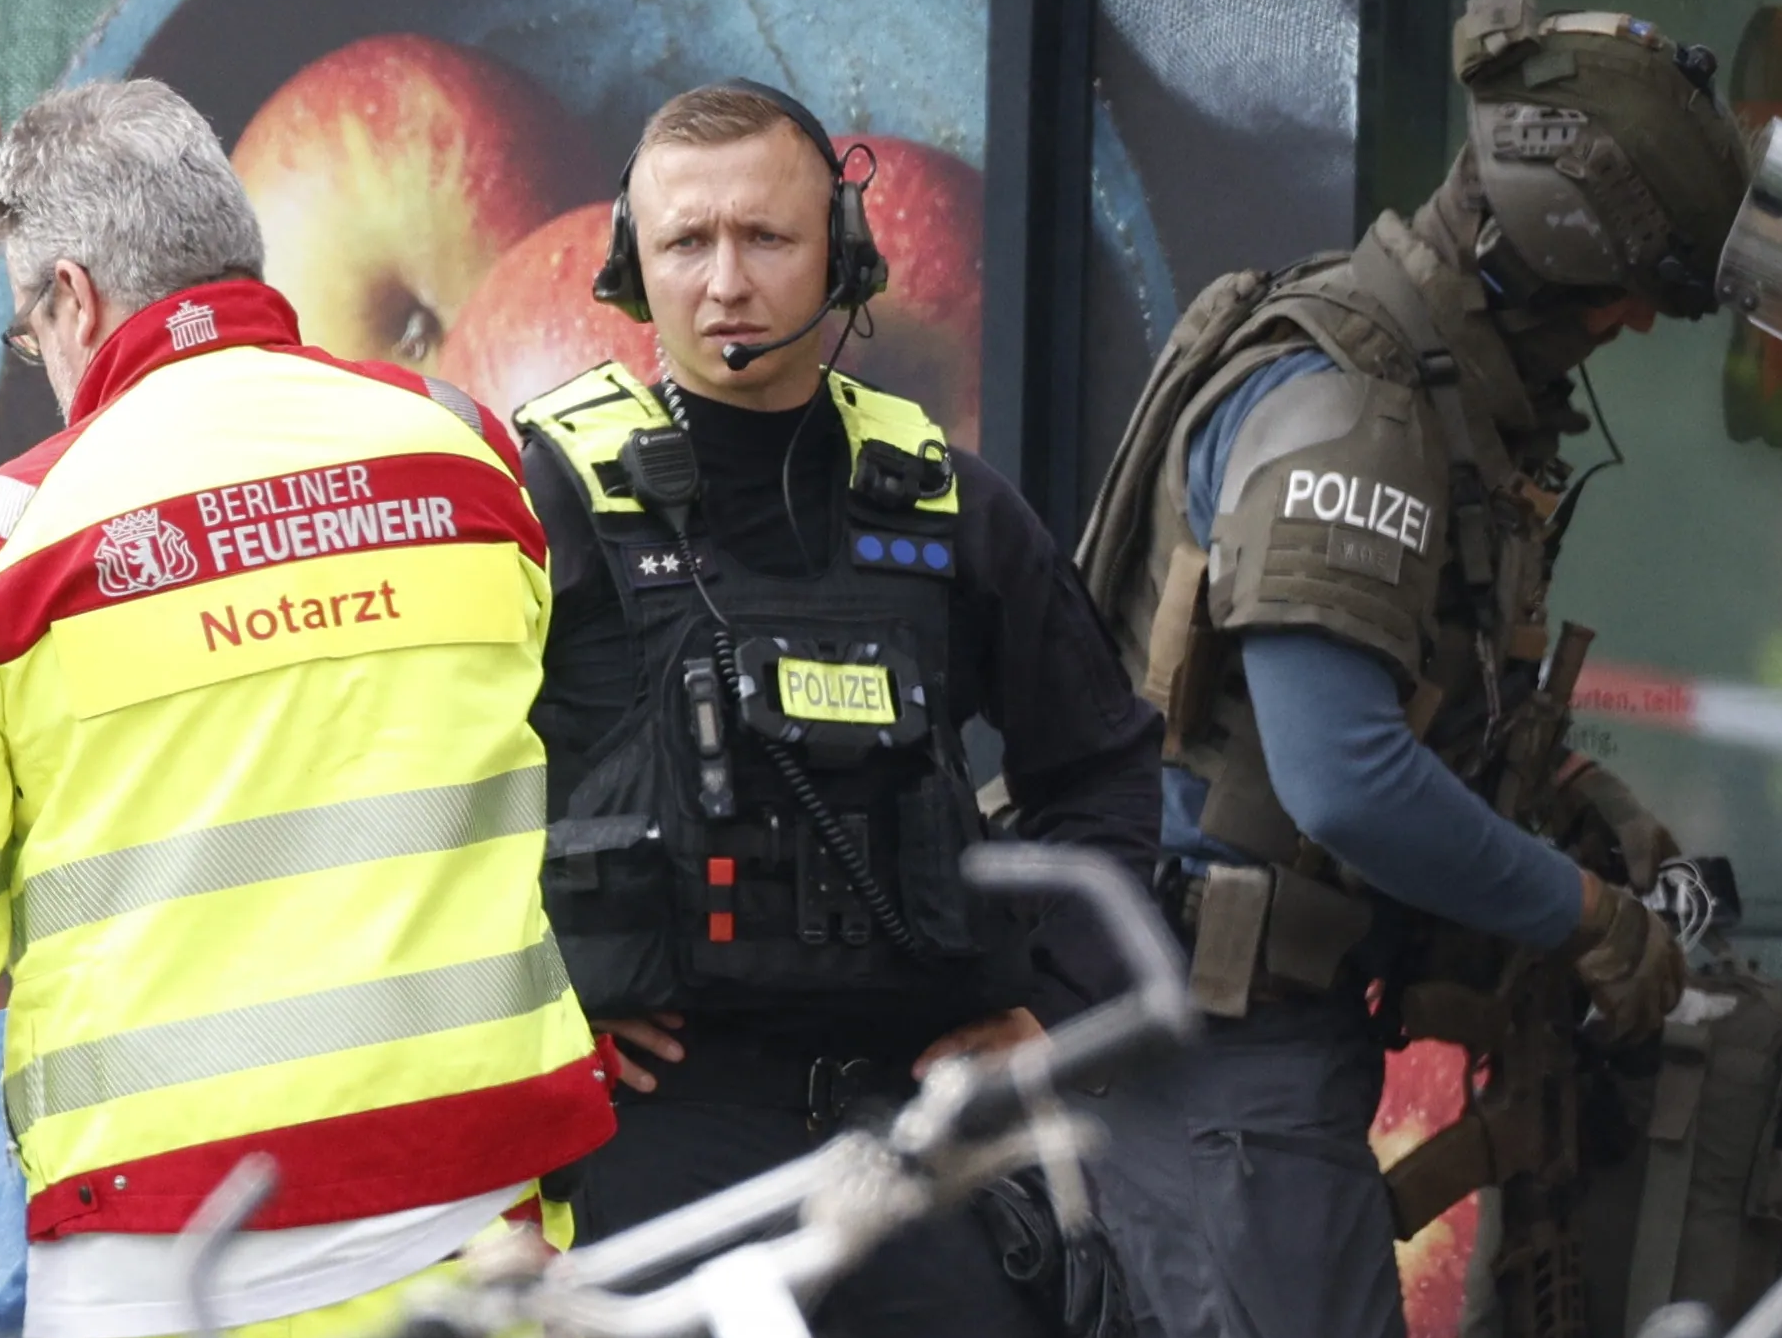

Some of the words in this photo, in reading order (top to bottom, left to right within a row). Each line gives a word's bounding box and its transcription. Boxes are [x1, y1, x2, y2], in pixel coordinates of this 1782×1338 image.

[196, 464, 373, 527] BERLINER
[1284, 469, 1431, 554] POLIZEI
[207, 496, 458, 573] FEUERWEHR
[199, 579, 402, 653] Notarzt
[787, 670, 887, 712] POLIZEI
